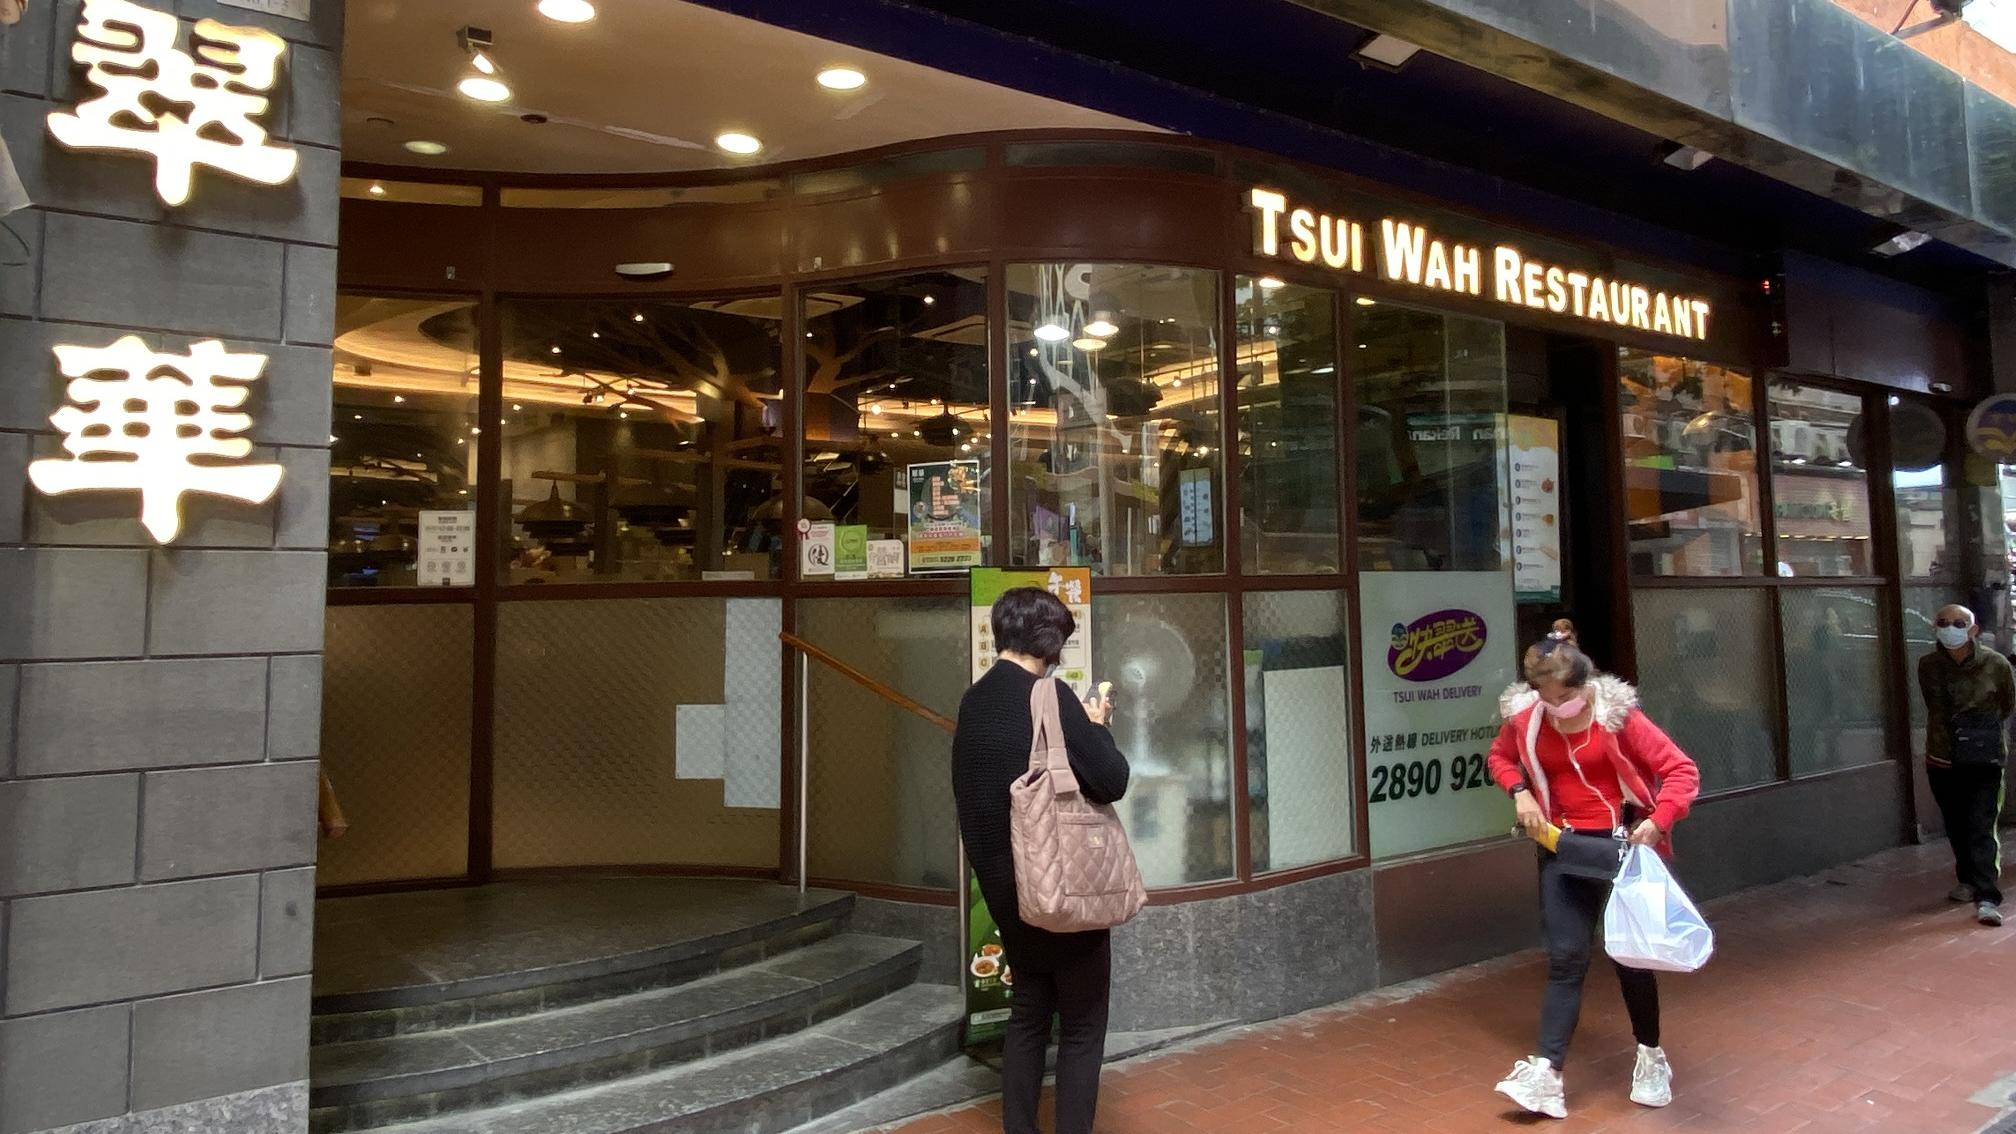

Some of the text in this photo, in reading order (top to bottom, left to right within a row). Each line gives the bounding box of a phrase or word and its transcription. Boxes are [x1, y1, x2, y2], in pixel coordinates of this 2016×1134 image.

[28, 0, 299, 544] 翠華
[1247, 187, 1711, 340] TSUI WAH RESTAURANT
[1393, 685, 1483, 704] TSUI WAH DELIVERY
[1421, 728, 1468, 747] DELIVERY
[1369, 758, 1442, 804] 2890
